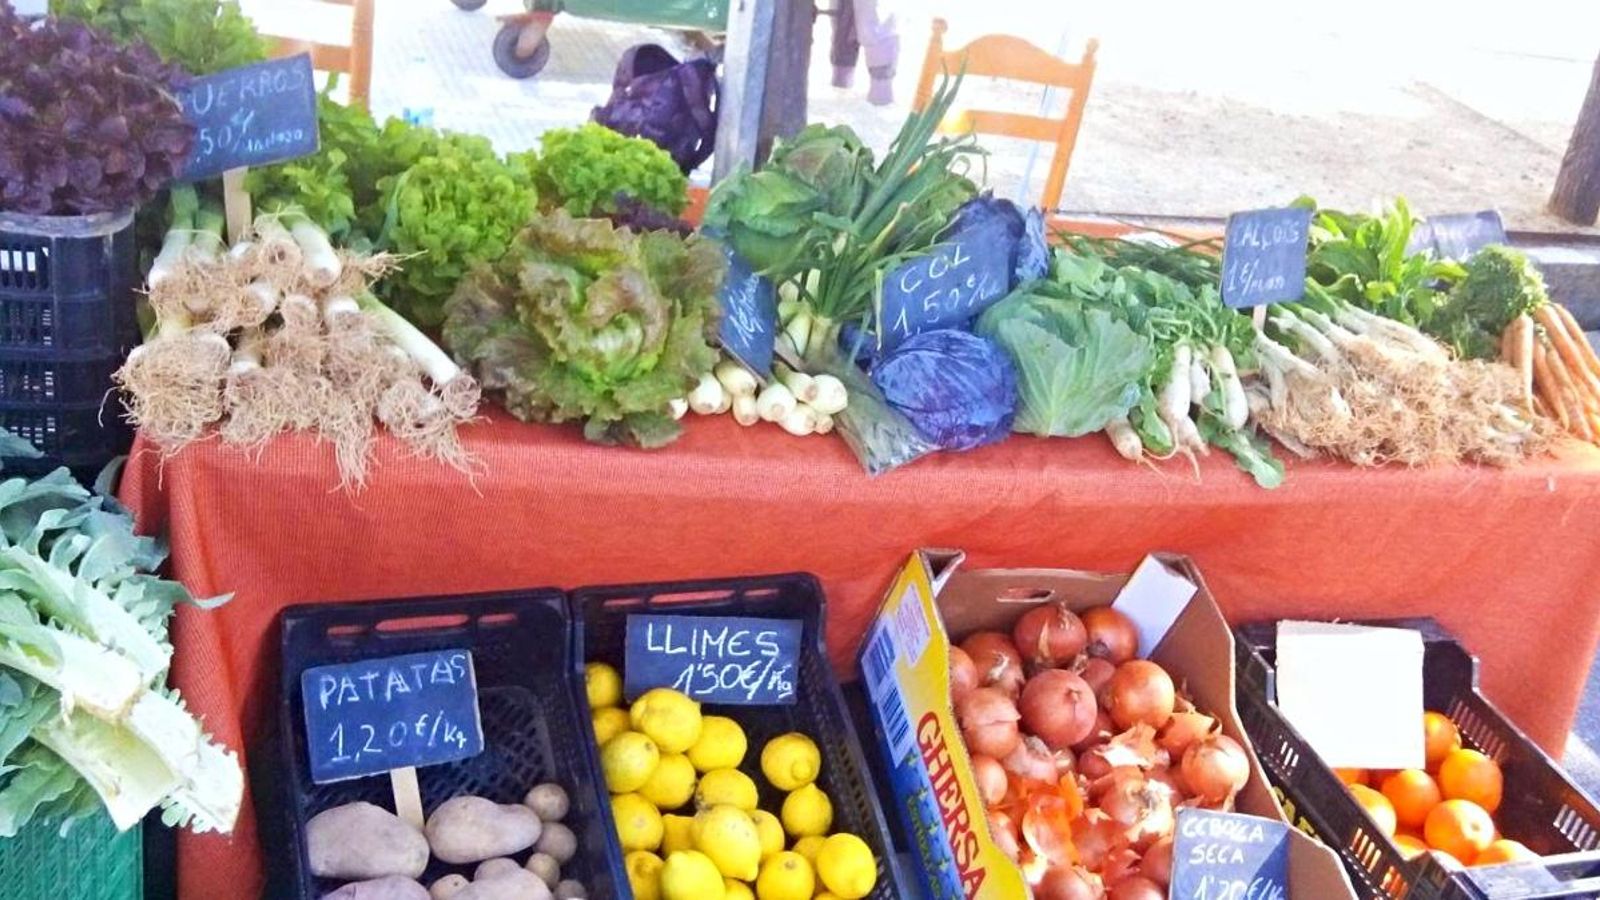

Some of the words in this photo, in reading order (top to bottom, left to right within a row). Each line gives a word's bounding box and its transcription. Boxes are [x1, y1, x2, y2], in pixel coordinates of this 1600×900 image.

[187, 64, 305, 115] UERROS
[647, 621, 780, 660] LLIMES
[319, 653, 466, 711] PATATAS
[916, 710, 987, 900] GHERSA
[1188, 843, 1244, 865] SECA
